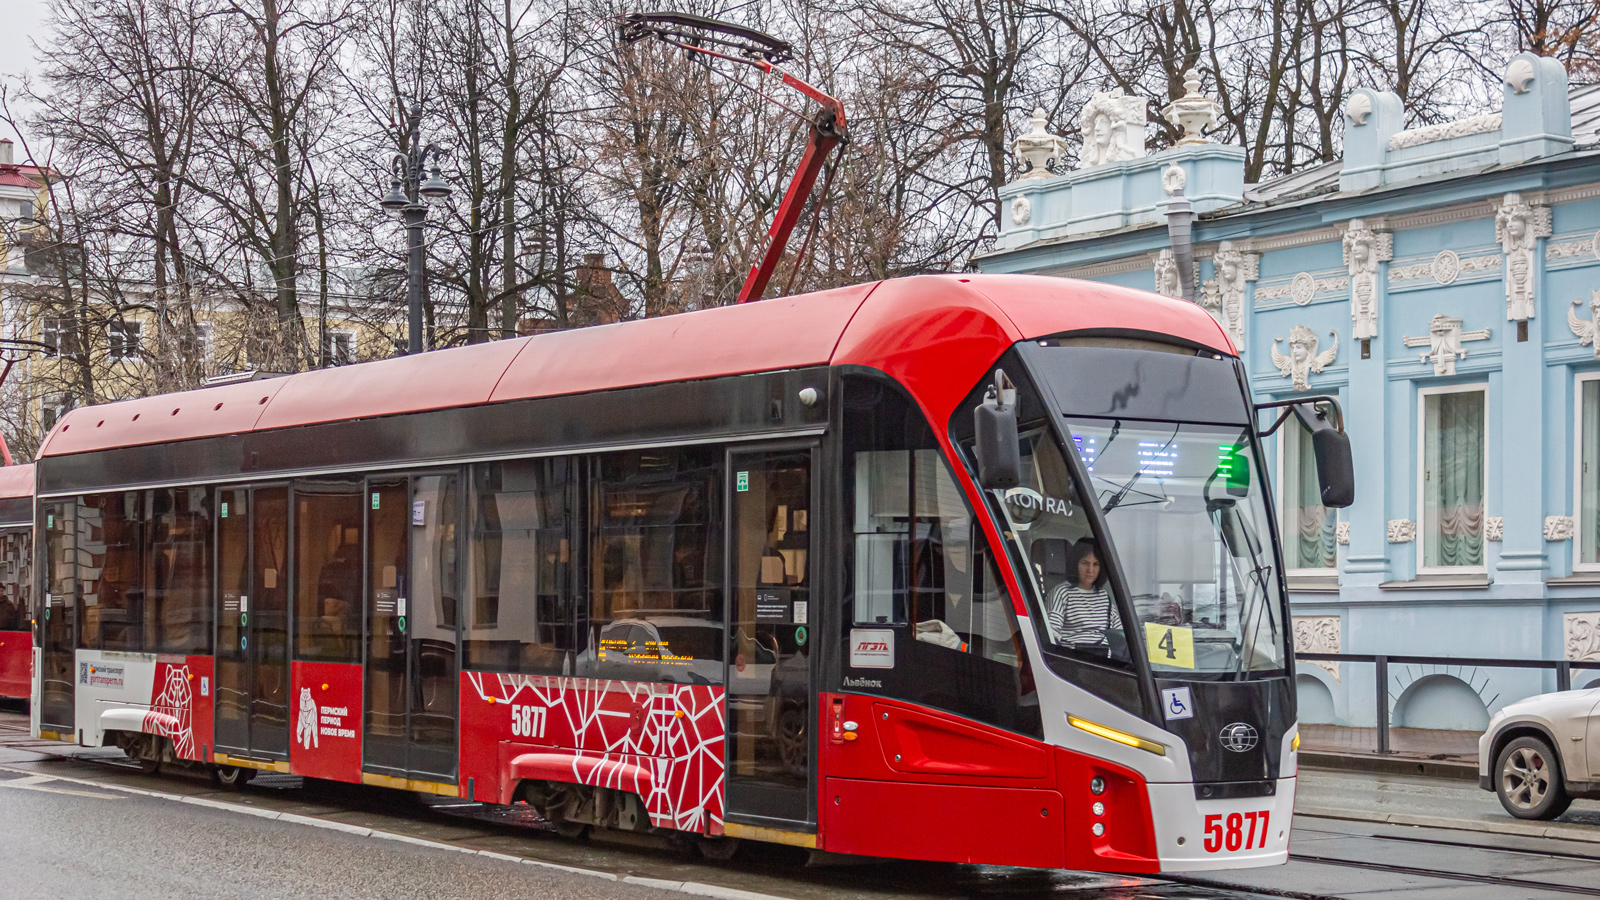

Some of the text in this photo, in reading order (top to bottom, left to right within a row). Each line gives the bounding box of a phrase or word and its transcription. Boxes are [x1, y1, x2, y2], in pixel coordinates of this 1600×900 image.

[1158, 628, 1177, 660] 4
[843, 676, 882, 688] Львёнок
[320, 705, 348, 717] ПЕРМСКИЙ
[320, 715, 341, 727] ПЕРИОД
[511, 704, 547, 739] 5877
[320, 726, 355, 739] НОВОЕ ВРЕМЯ
[1203, 809, 1270, 854] 5877
